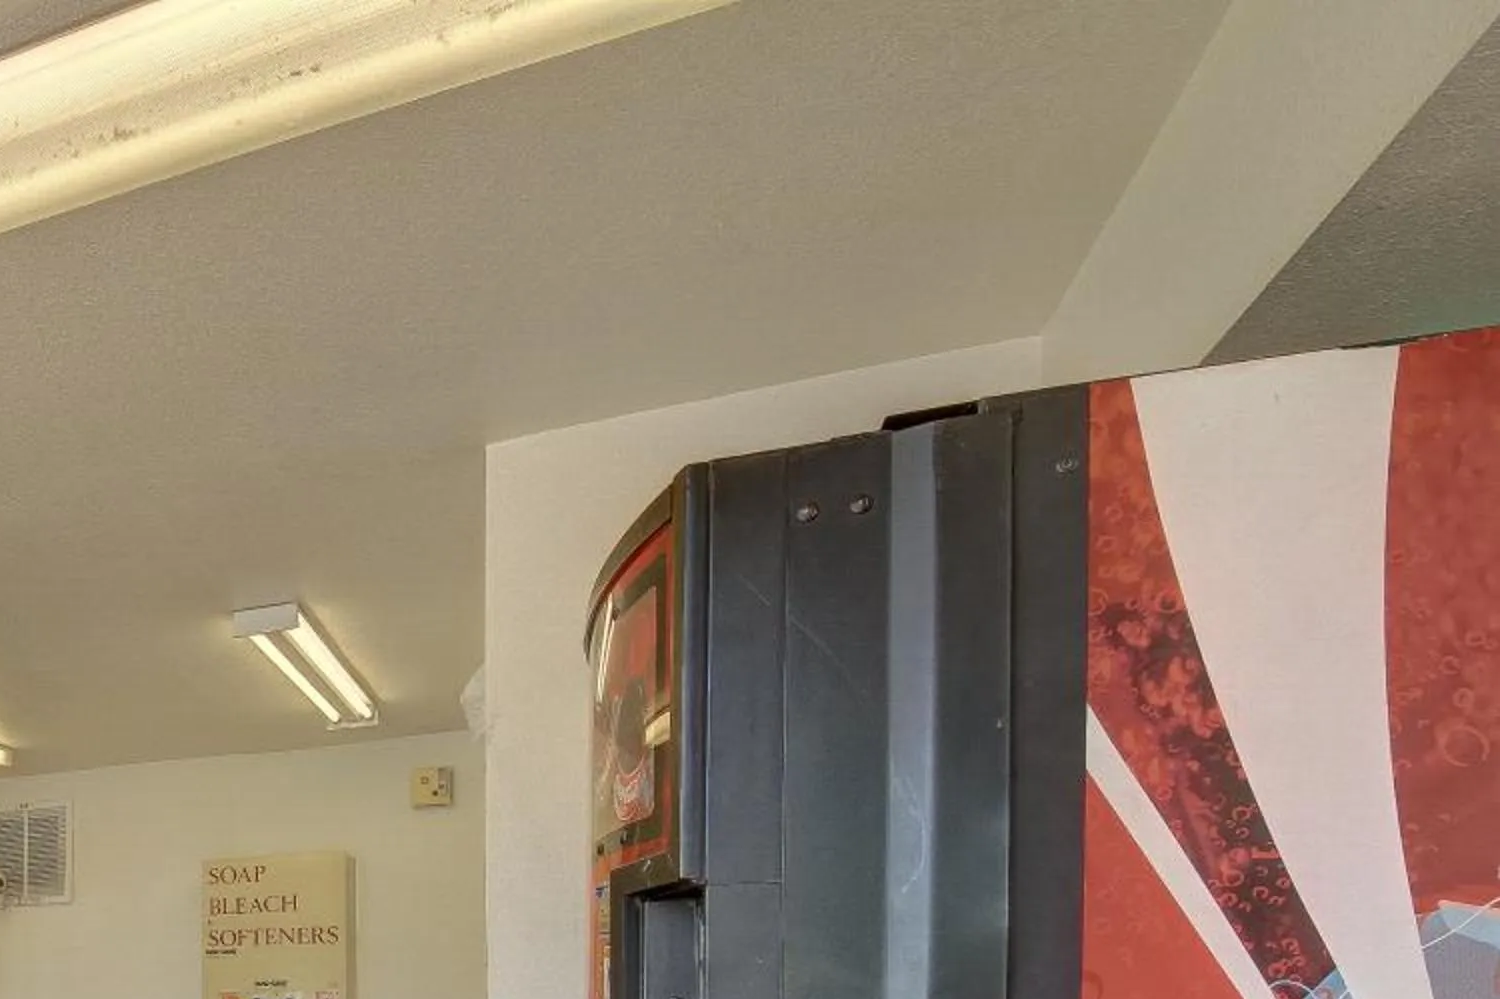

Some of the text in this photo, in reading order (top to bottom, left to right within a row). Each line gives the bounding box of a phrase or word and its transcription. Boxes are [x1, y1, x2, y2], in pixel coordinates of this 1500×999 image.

[208, 864, 266, 885] SOAP
[209, 894, 298, 917] BLEACH
[207, 924, 340, 949] SOFTENERS
